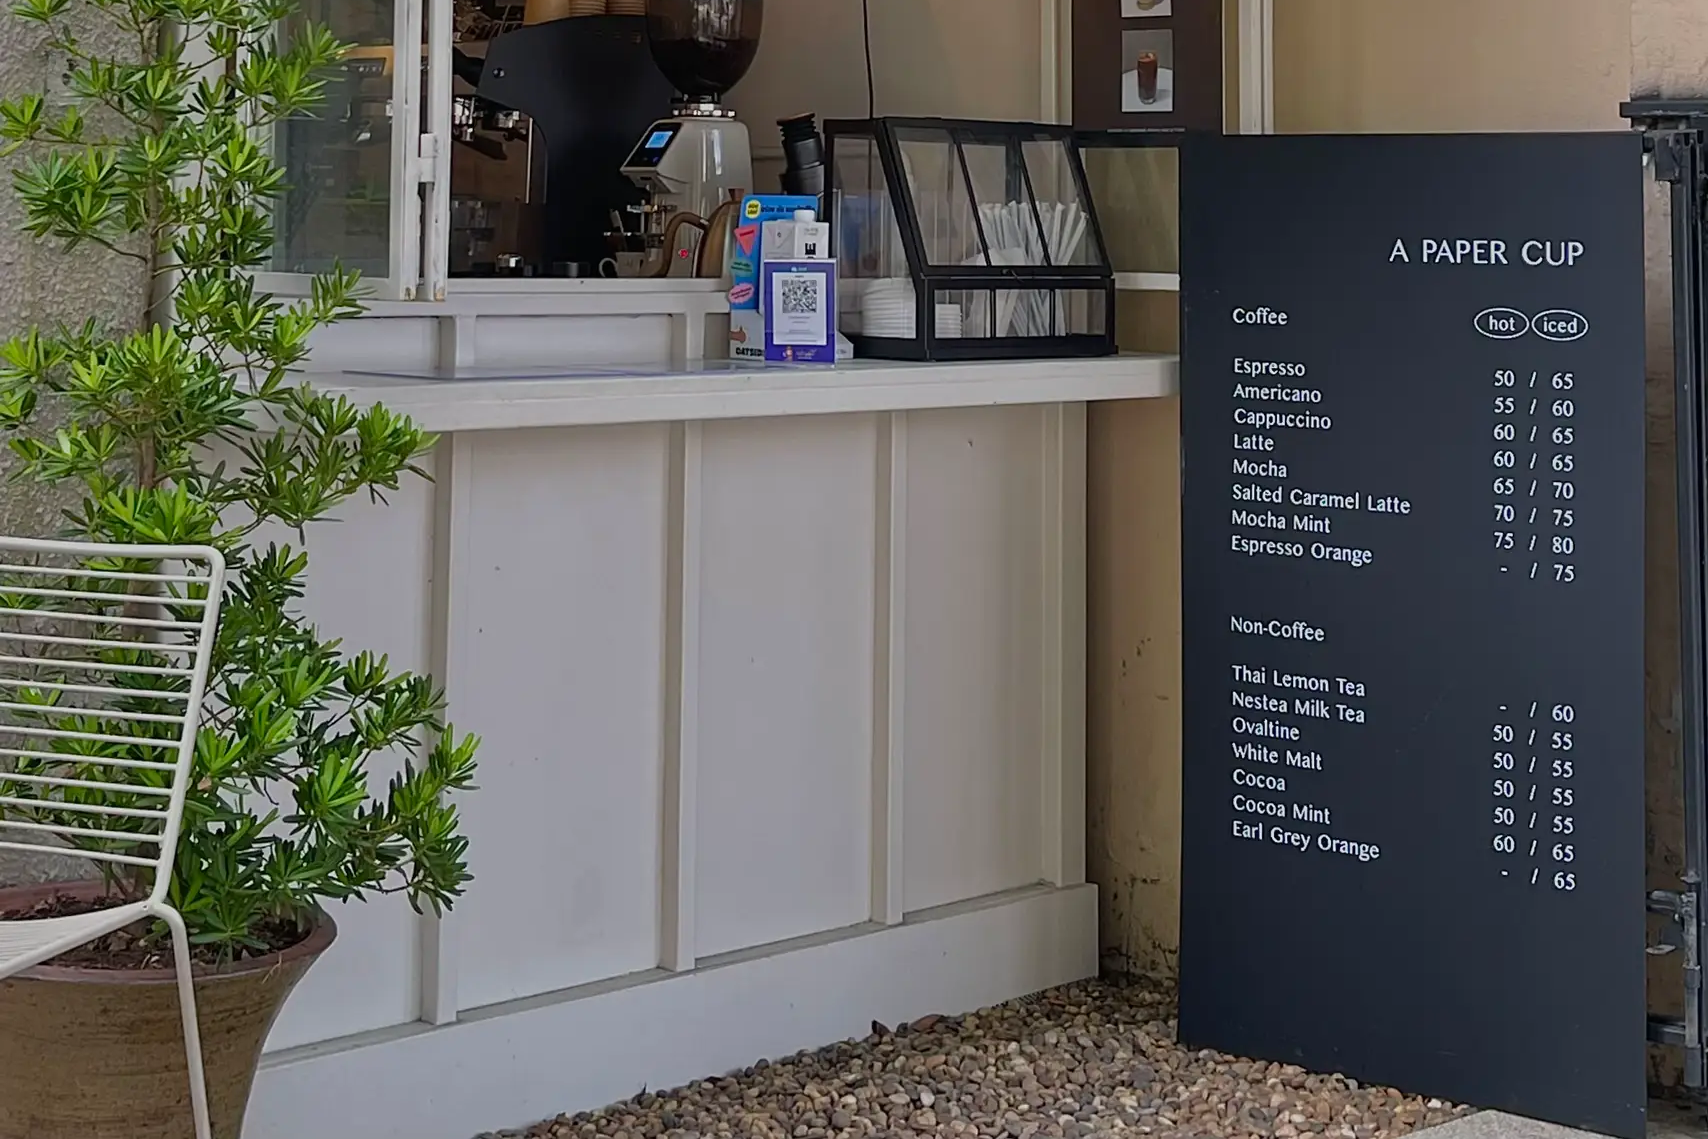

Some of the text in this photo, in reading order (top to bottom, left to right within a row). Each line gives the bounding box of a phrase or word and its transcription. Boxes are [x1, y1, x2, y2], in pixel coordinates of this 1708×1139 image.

[1389, 239, 1583, 265] A PAPER CUP
[1232, 308, 1287, 324] Coffee
[1489, 315, 1577, 333] hot iced
[1234, 358, 1305, 377] Espresso
[1494, 371, 1573, 389] 50 / 65
[1233, 384, 1321, 402] Americano
[1494, 397, 1573, 416] 55 / 60
[1234, 409, 1331, 429] Cappuccino
[1234, 434, 1273, 450] Latte
[1493, 424, 1573, 444] 60 / 65
[1233, 459, 1286, 477] Mocha
[1493, 451, 1573, 471] 60 / 65
[1232, 484, 1410, 513] Salted Caramel Latte
[1493, 478, 1573, 498] 65 / 70
[1231, 510, 1330, 533] Mocha Mint
[1494, 505, 1573, 526] 70 / 75
[1231, 536, 1371, 566] Espresso Orange
[1494, 532, 1573, 554] 75 / 80
[1530, 562, 1538, 579] /
[1553, 565, 1573, 581] 75
[1231, 617, 1324, 641] Non-Coffee
[1231, 665, 1364, 696] Thai Lemon Tea
[1232, 692, 1364, 722] Nestea Milk Tea
[1529, 701, 1537, 718] /
[1552, 705, 1573, 722] 60
[1232, 718, 1299, 740] Ovaltine
[1493, 725, 1572, 750] 50 / 55
[1231, 743, 1321, 770] White Malt
[1493, 753, 1572, 777] 50 / 55
[1232, 769, 1285, 790] Cocoa
[1493, 780, 1572, 805] 50 / 55
[1232, 795, 1330, 824] Cocoa Mint
[1493, 807, 1573, 833] 50 / 55
[1233, 821, 1379, 861] Earl Grey Orange
[1493, 835, 1573, 861] 60 / 65
[1531, 868, 1539, 884] /
[1554, 872, 1575, 890] 65
